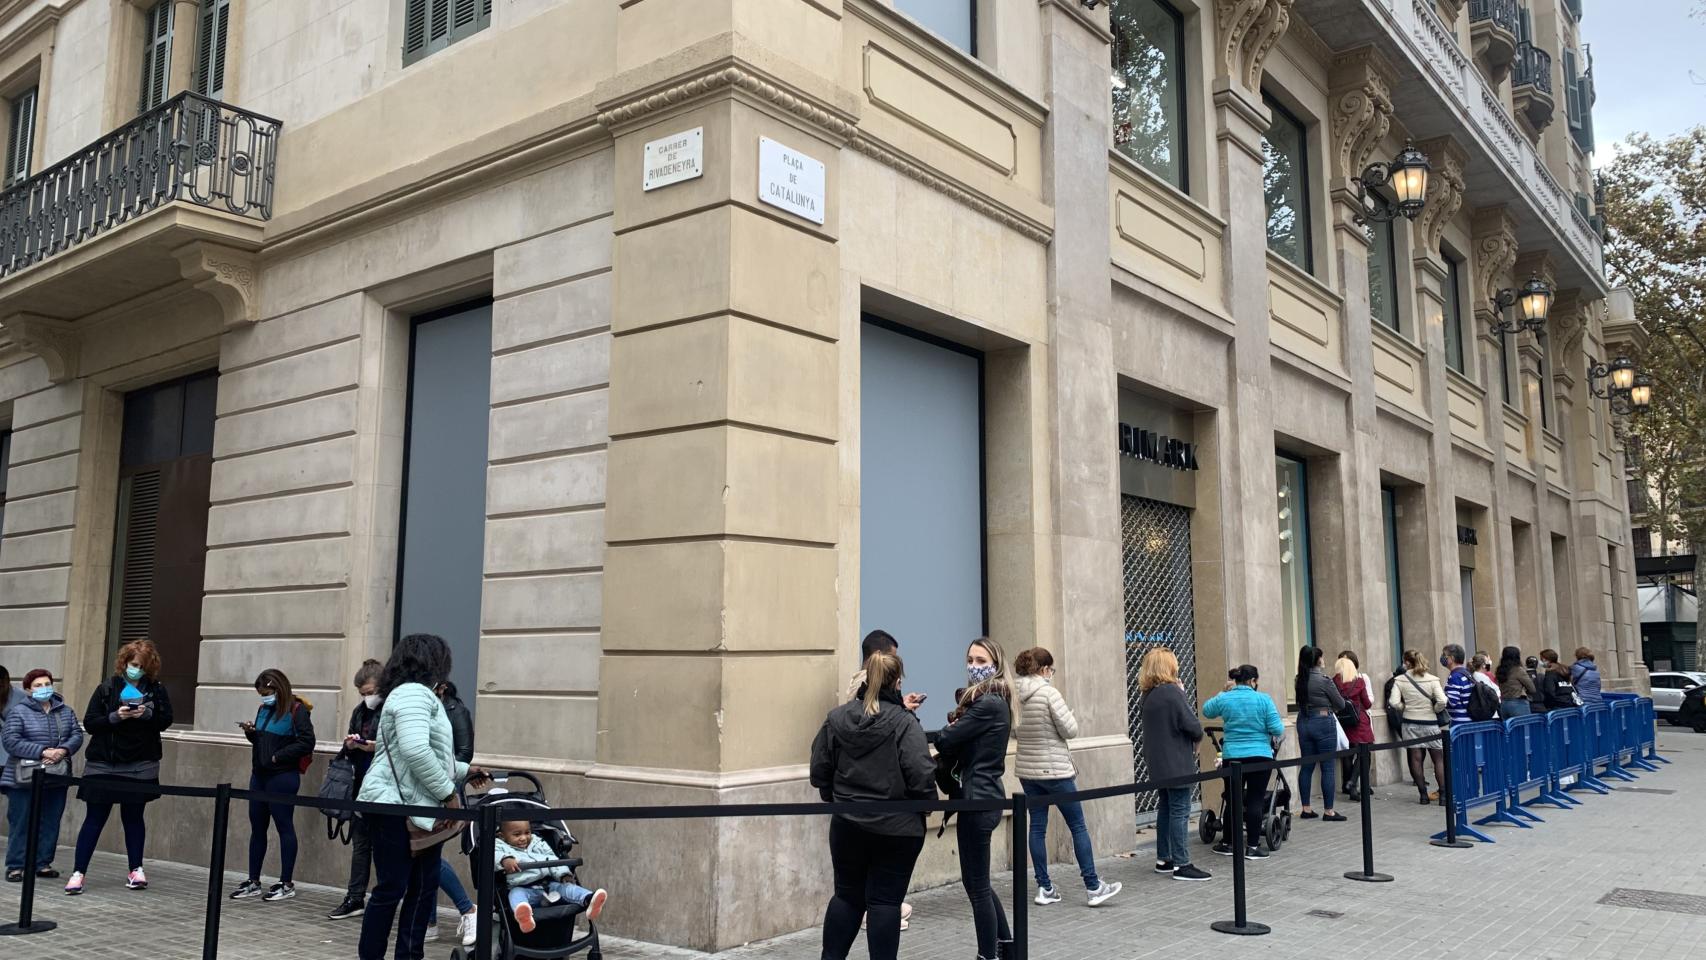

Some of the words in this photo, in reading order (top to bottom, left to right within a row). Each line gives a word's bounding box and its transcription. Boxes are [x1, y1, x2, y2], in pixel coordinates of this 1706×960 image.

[658, 139, 687, 154] CARRER
[667, 152, 678, 161] DE
[783, 154, 804, 171] PLAÇA
[648, 158, 696, 180] RIVADENEYRA
[789, 173, 798, 185] DE
[770, 183, 816, 212] CATALUNYA
[1119, 422, 1200, 471] RIMARK
